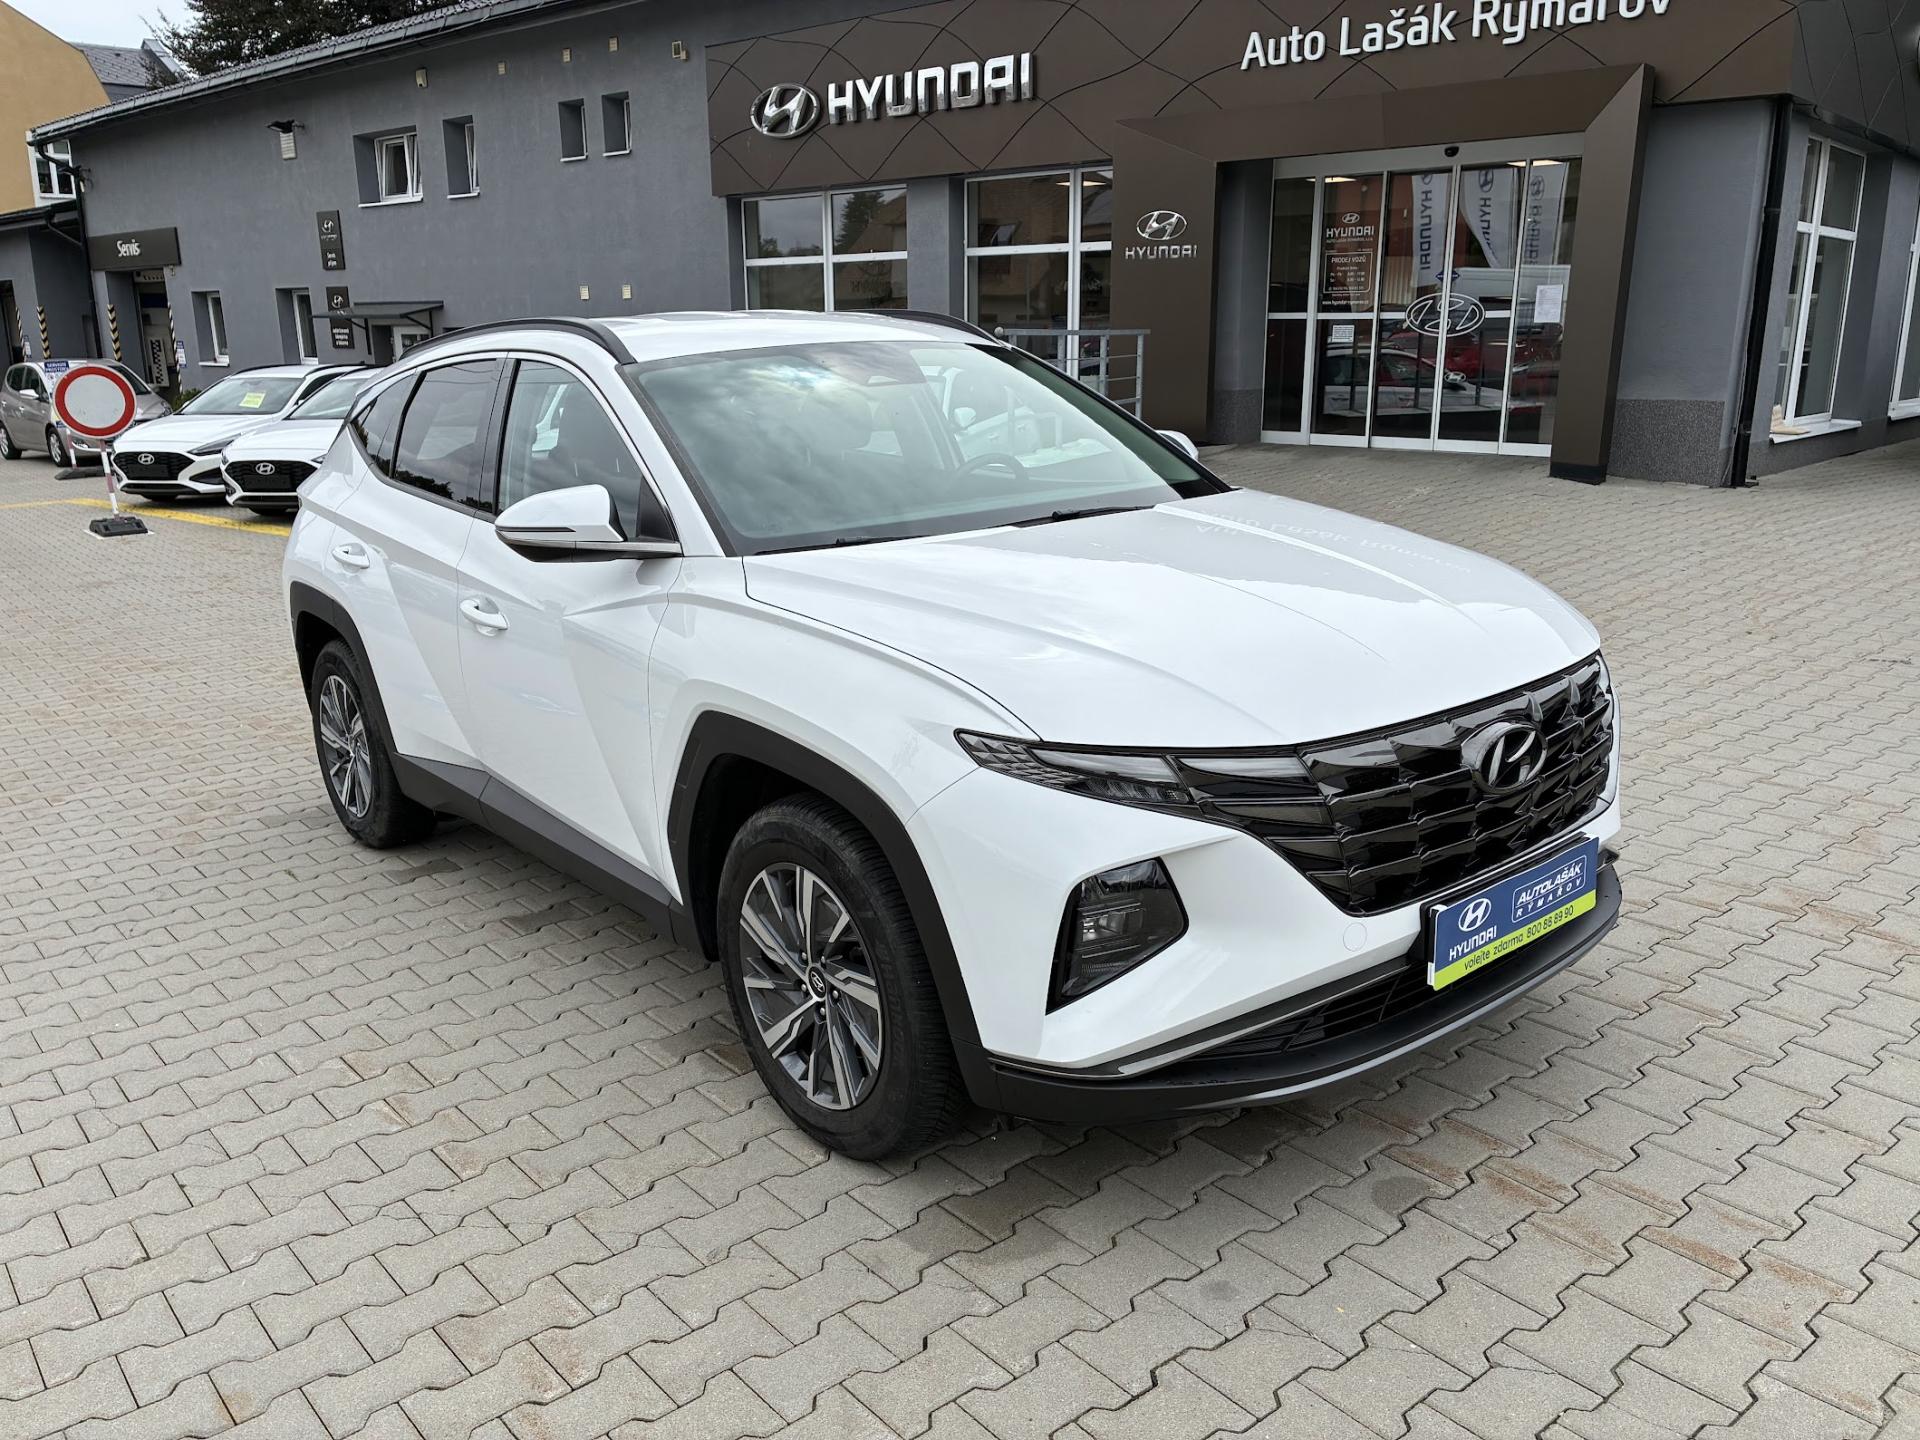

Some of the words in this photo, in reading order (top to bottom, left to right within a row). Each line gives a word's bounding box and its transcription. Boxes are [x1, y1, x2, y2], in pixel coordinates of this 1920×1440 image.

[1240, 25, 1326, 71] Auto
[1339, 2, 1460, 57] Lašák
[827, 52, 1034, 125] HYUNDAI
[116, 238, 141, 257] Servis
[1325, 225, 1375, 239] HYUNDAI
[1125, 244, 1198, 260] HYUNDAI
[1516, 862, 1583, 905] AUTOLAŠÁK
[1449, 925, 1498, 961] HYUNDAI
[1464, 950, 1491, 971] volejte
[1493, 932, 1524, 956] zdarma
[1526, 921, 1542, 939] 800
[1564, 904, 1575, 919] 90
